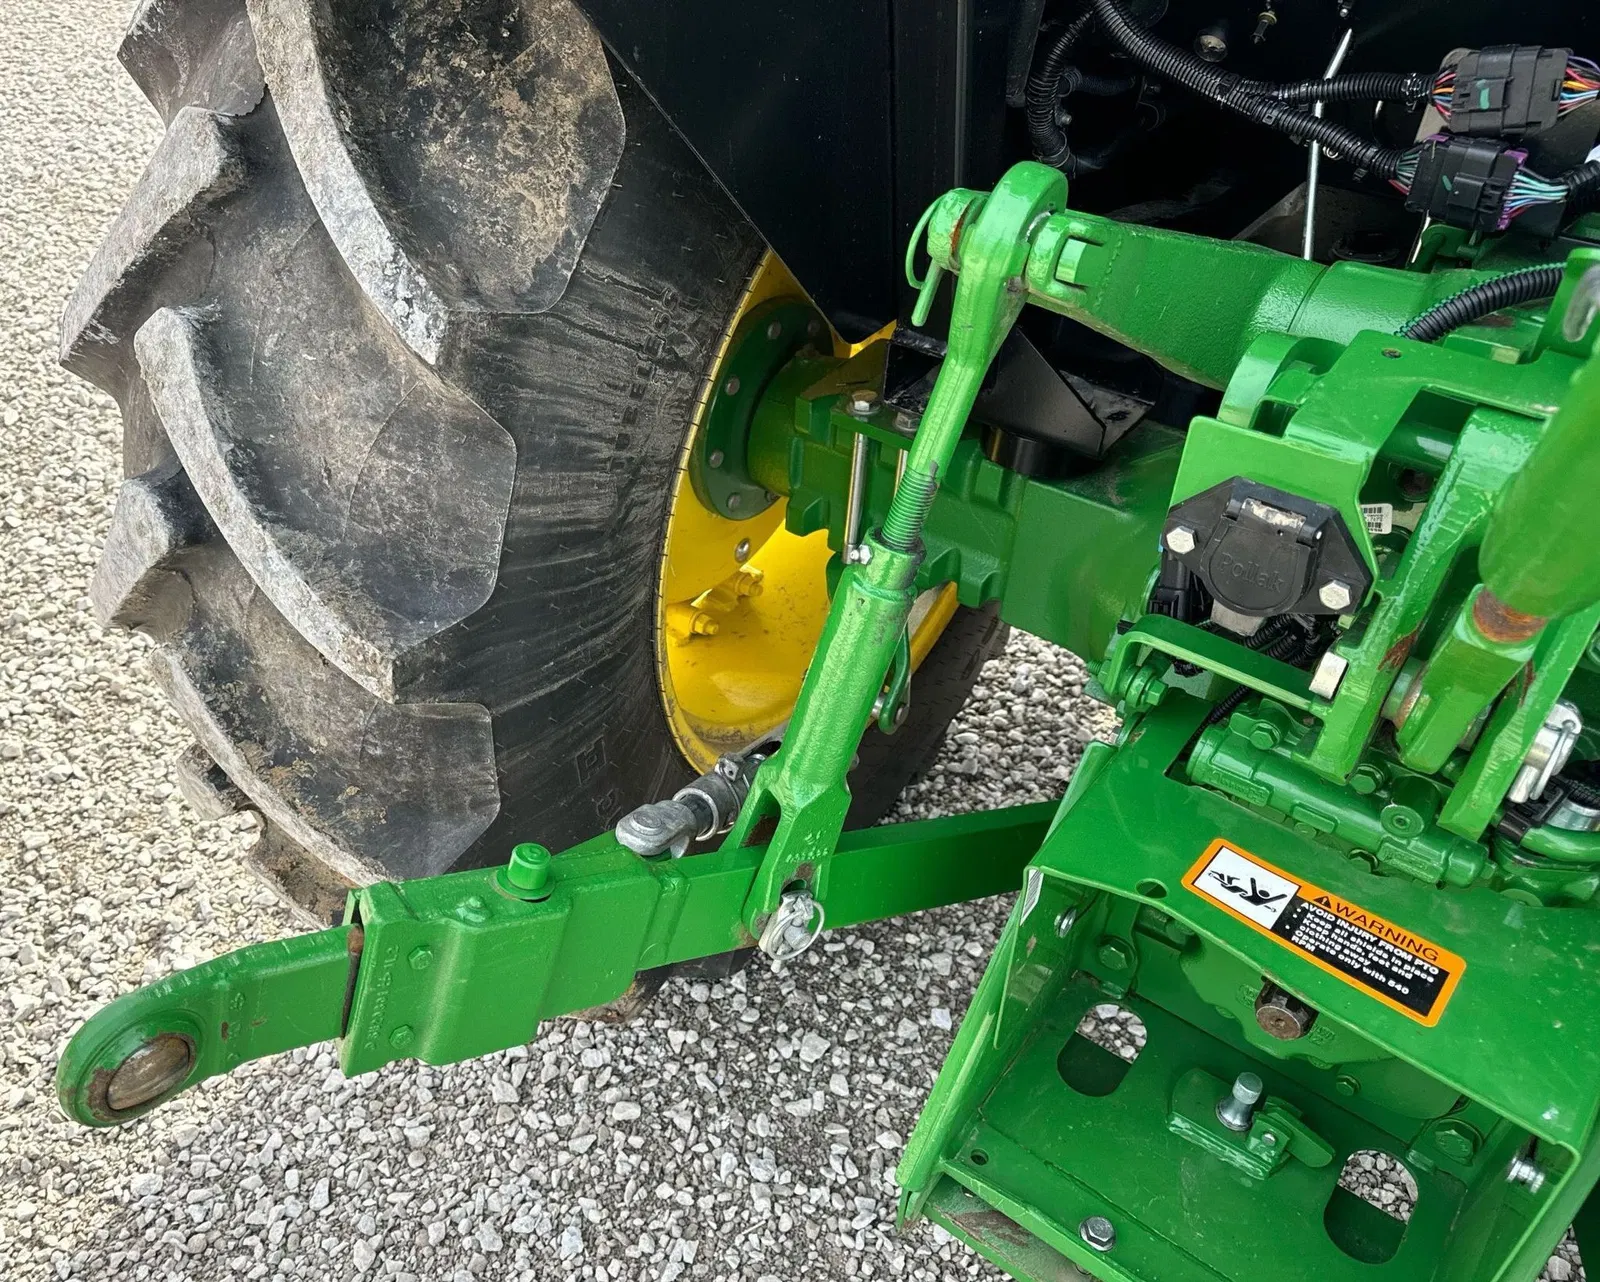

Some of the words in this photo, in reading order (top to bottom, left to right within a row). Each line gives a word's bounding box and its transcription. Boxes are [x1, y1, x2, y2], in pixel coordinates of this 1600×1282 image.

[1218, 551, 1285, 593] Pollak
[1291, 934, 1316, 953] RPM
[1295, 929, 1337, 956] Operate
[1338, 954, 1361, 970] only
[1362, 966, 1387, 983] with
[1387, 979, 1410, 995] 540
[1299, 925, 1342, 951] clothing
[1343, 948, 1371, 967] away
[1301, 902, 1336, 922] AVOID
[1336, 918, 1378, 943] INJURY
[1378, 940, 1413, 962] FROM
[1414, 958, 1439, 975] PTO
[1302, 918, 1329, 936] Keep
[1331, 932, 1365, 957] hands,
[1391, 965, 1413, 980] and
[1306, 912, 1332, 930] Keep
[1334, 928, 1349, 938] all
[1350, 936, 1389, 959] shields
[1391, 956, 1402, 967] in
[1403, 963, 1435, 983] place
[1336, 902, 1439, 962] WARNING
